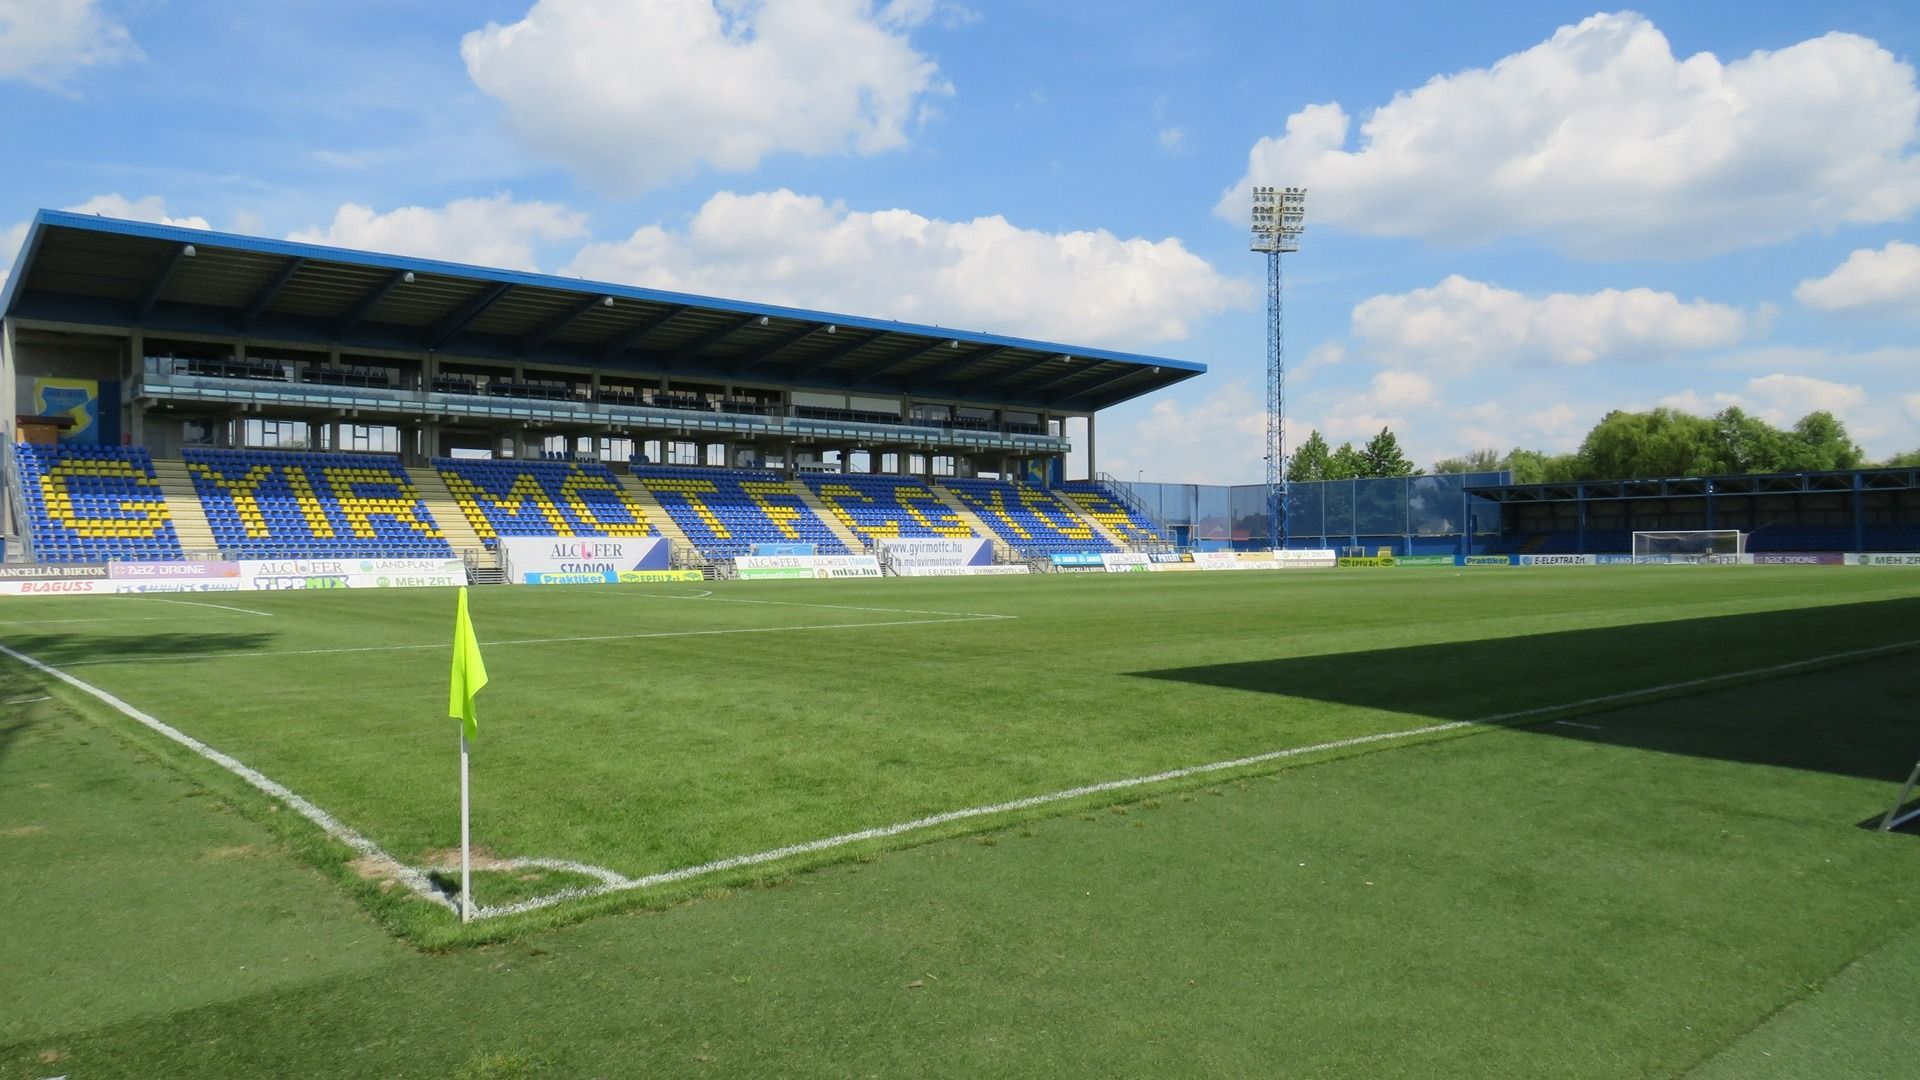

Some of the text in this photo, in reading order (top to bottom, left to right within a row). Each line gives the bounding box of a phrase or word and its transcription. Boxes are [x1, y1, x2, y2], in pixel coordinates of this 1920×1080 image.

[376, 560, 434, 570] LAND-PLAN
[1466, 557, 1507, 565] Praktiker
[1534, 556, 1573, 564] E-ELEKTRA
[1875, 556, 1902, 564] MEH
[63, 566, 106, 576] BIRTOK
[128, 565, 206, 575] ABZ DRONE
[832, 567, 878, 577] mlsz.hu
[396, 576, 426, 587] MEH
[544, 573, 603, 584] Praktiker
[20, 581, 94, 593] BLAGUSS
